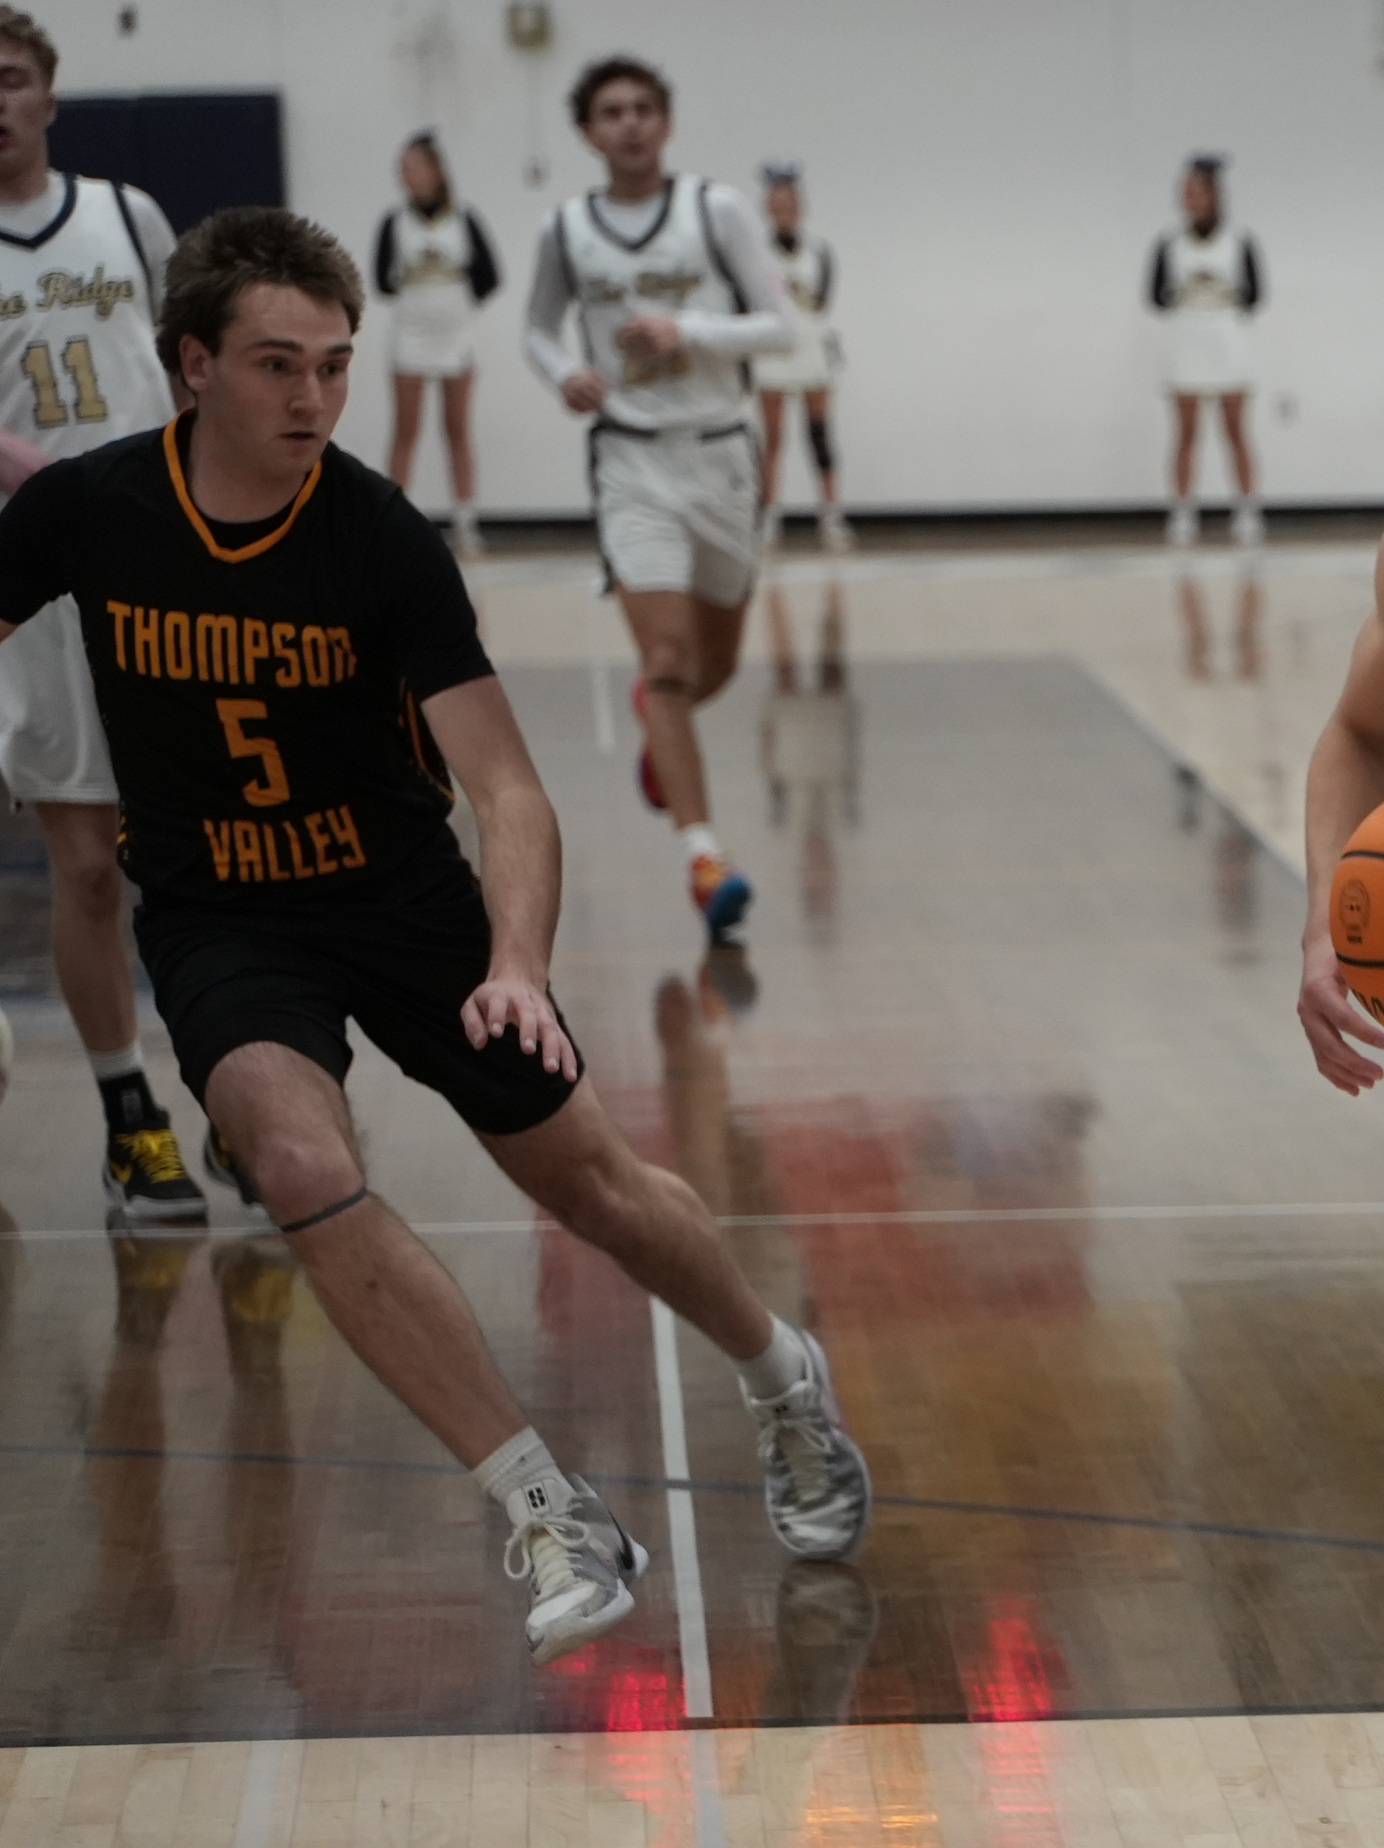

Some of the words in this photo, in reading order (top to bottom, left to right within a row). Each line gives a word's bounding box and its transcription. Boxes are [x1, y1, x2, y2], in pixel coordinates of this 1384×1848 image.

[20, 335, 107, 428] 11
[107, 600, 357, 688] THOMPSON
[216, 698, 290, 807] 5
[203, 805, 366, 882] VALLEY
